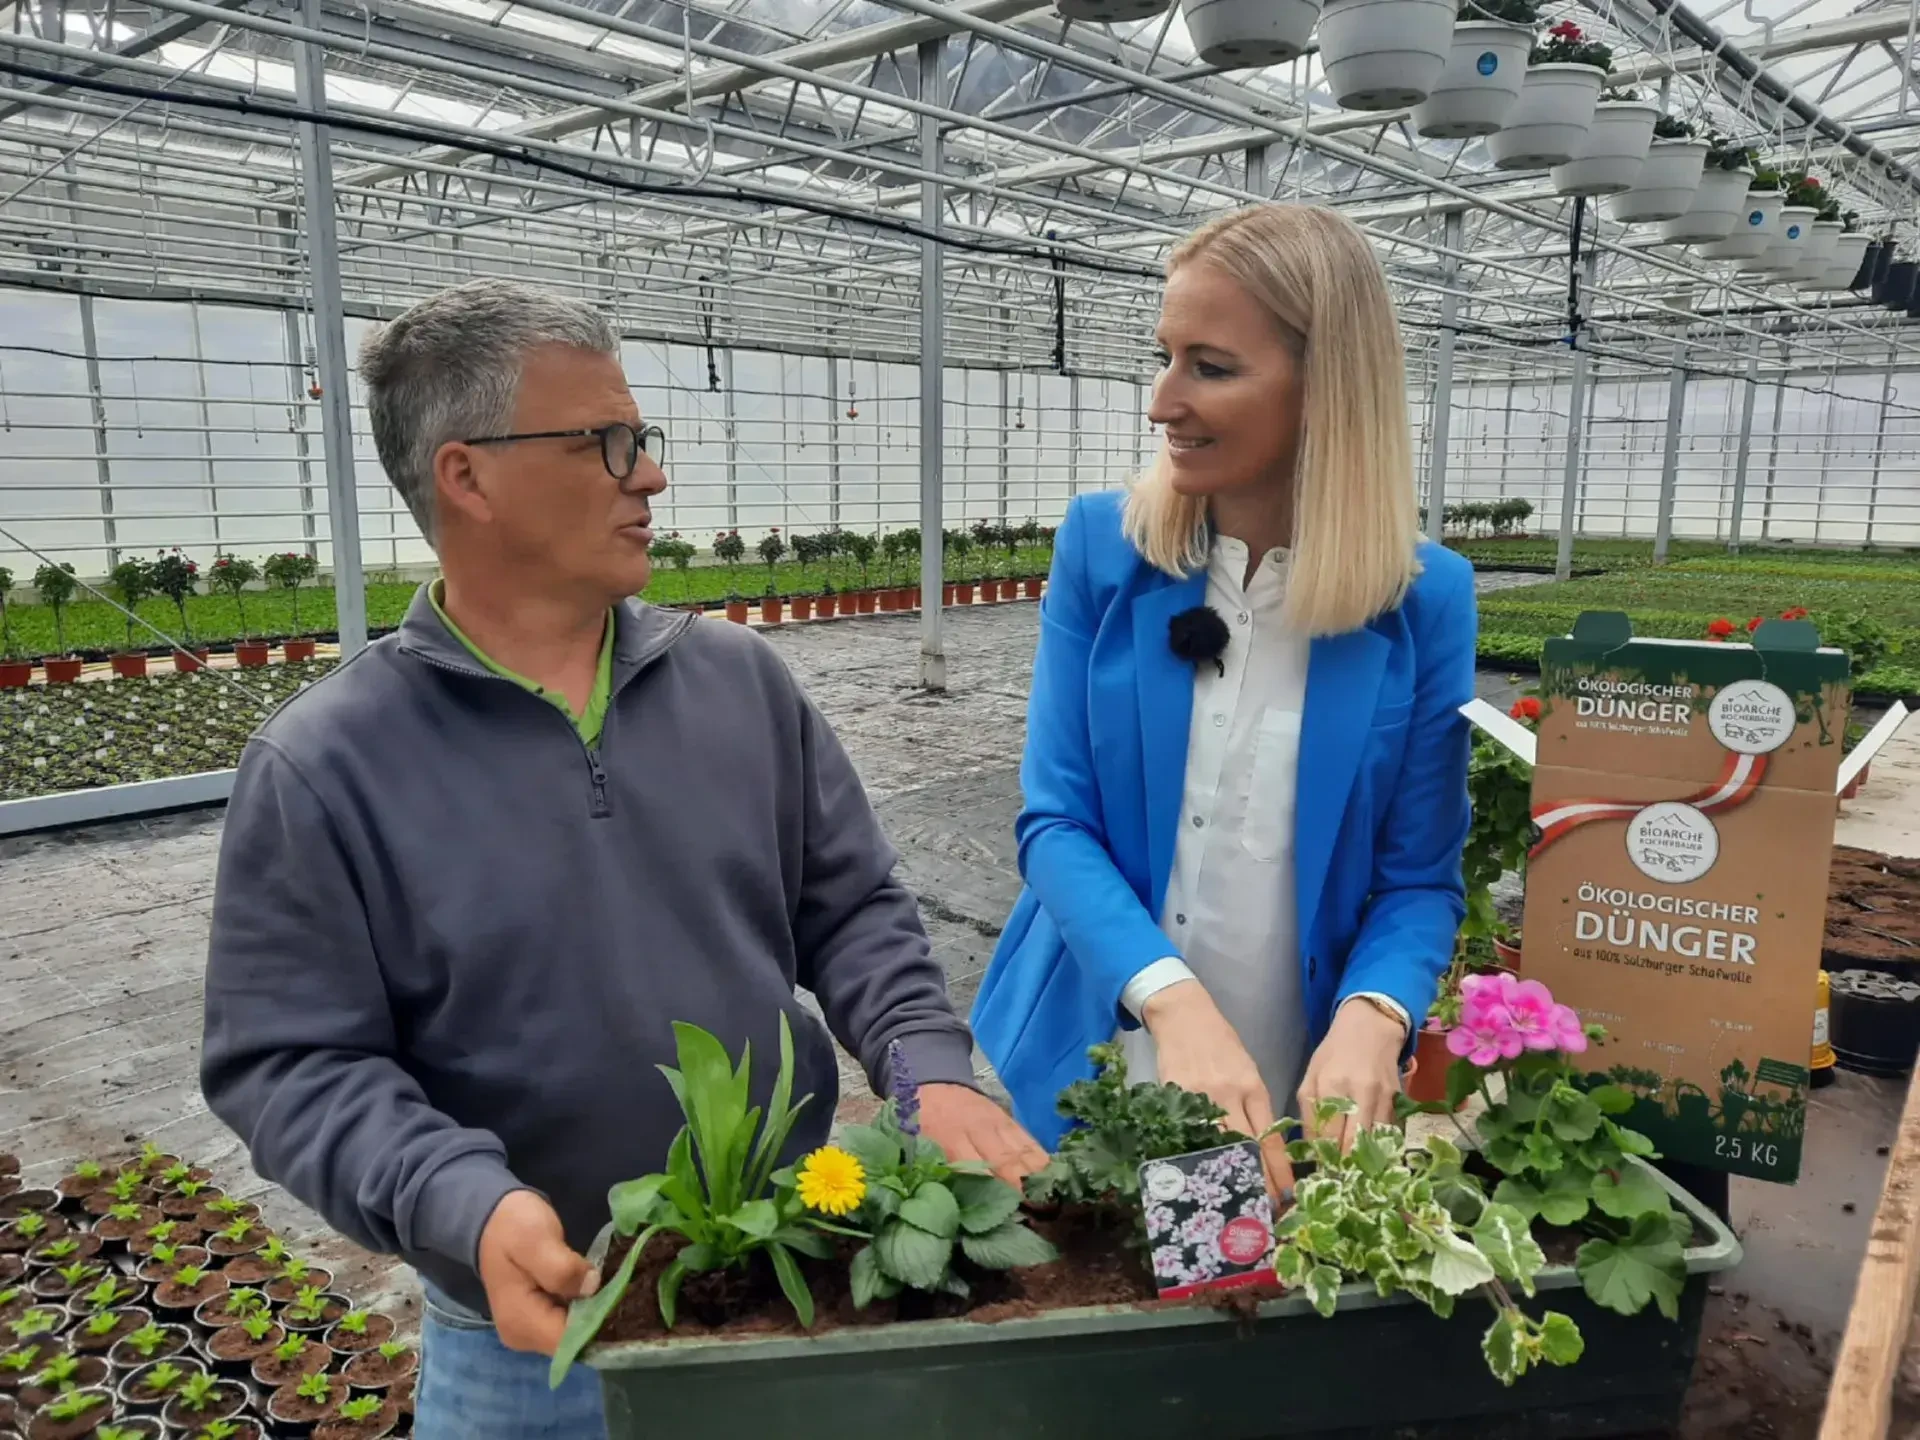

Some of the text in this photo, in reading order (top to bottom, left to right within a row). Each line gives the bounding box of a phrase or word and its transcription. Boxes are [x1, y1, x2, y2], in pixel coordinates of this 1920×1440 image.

[1578, 677, 1692, 698] ÖKOLOGISCHER
[1577, 694, 1691, 725] DÜNGER
[1721, 703, 1782, 717] BIOARCHE
[1639, 825, 1704, 843] BIOARCHE
[1577, 881, 1759, 925] ÖKOLOGISCHER
[1575, 908, 1757, 965] DÜNGER
[1573, 947, 1753, 984] aus 100% Salzburger Schafwolle
[1751, 1141, 1778, 1167] KG
